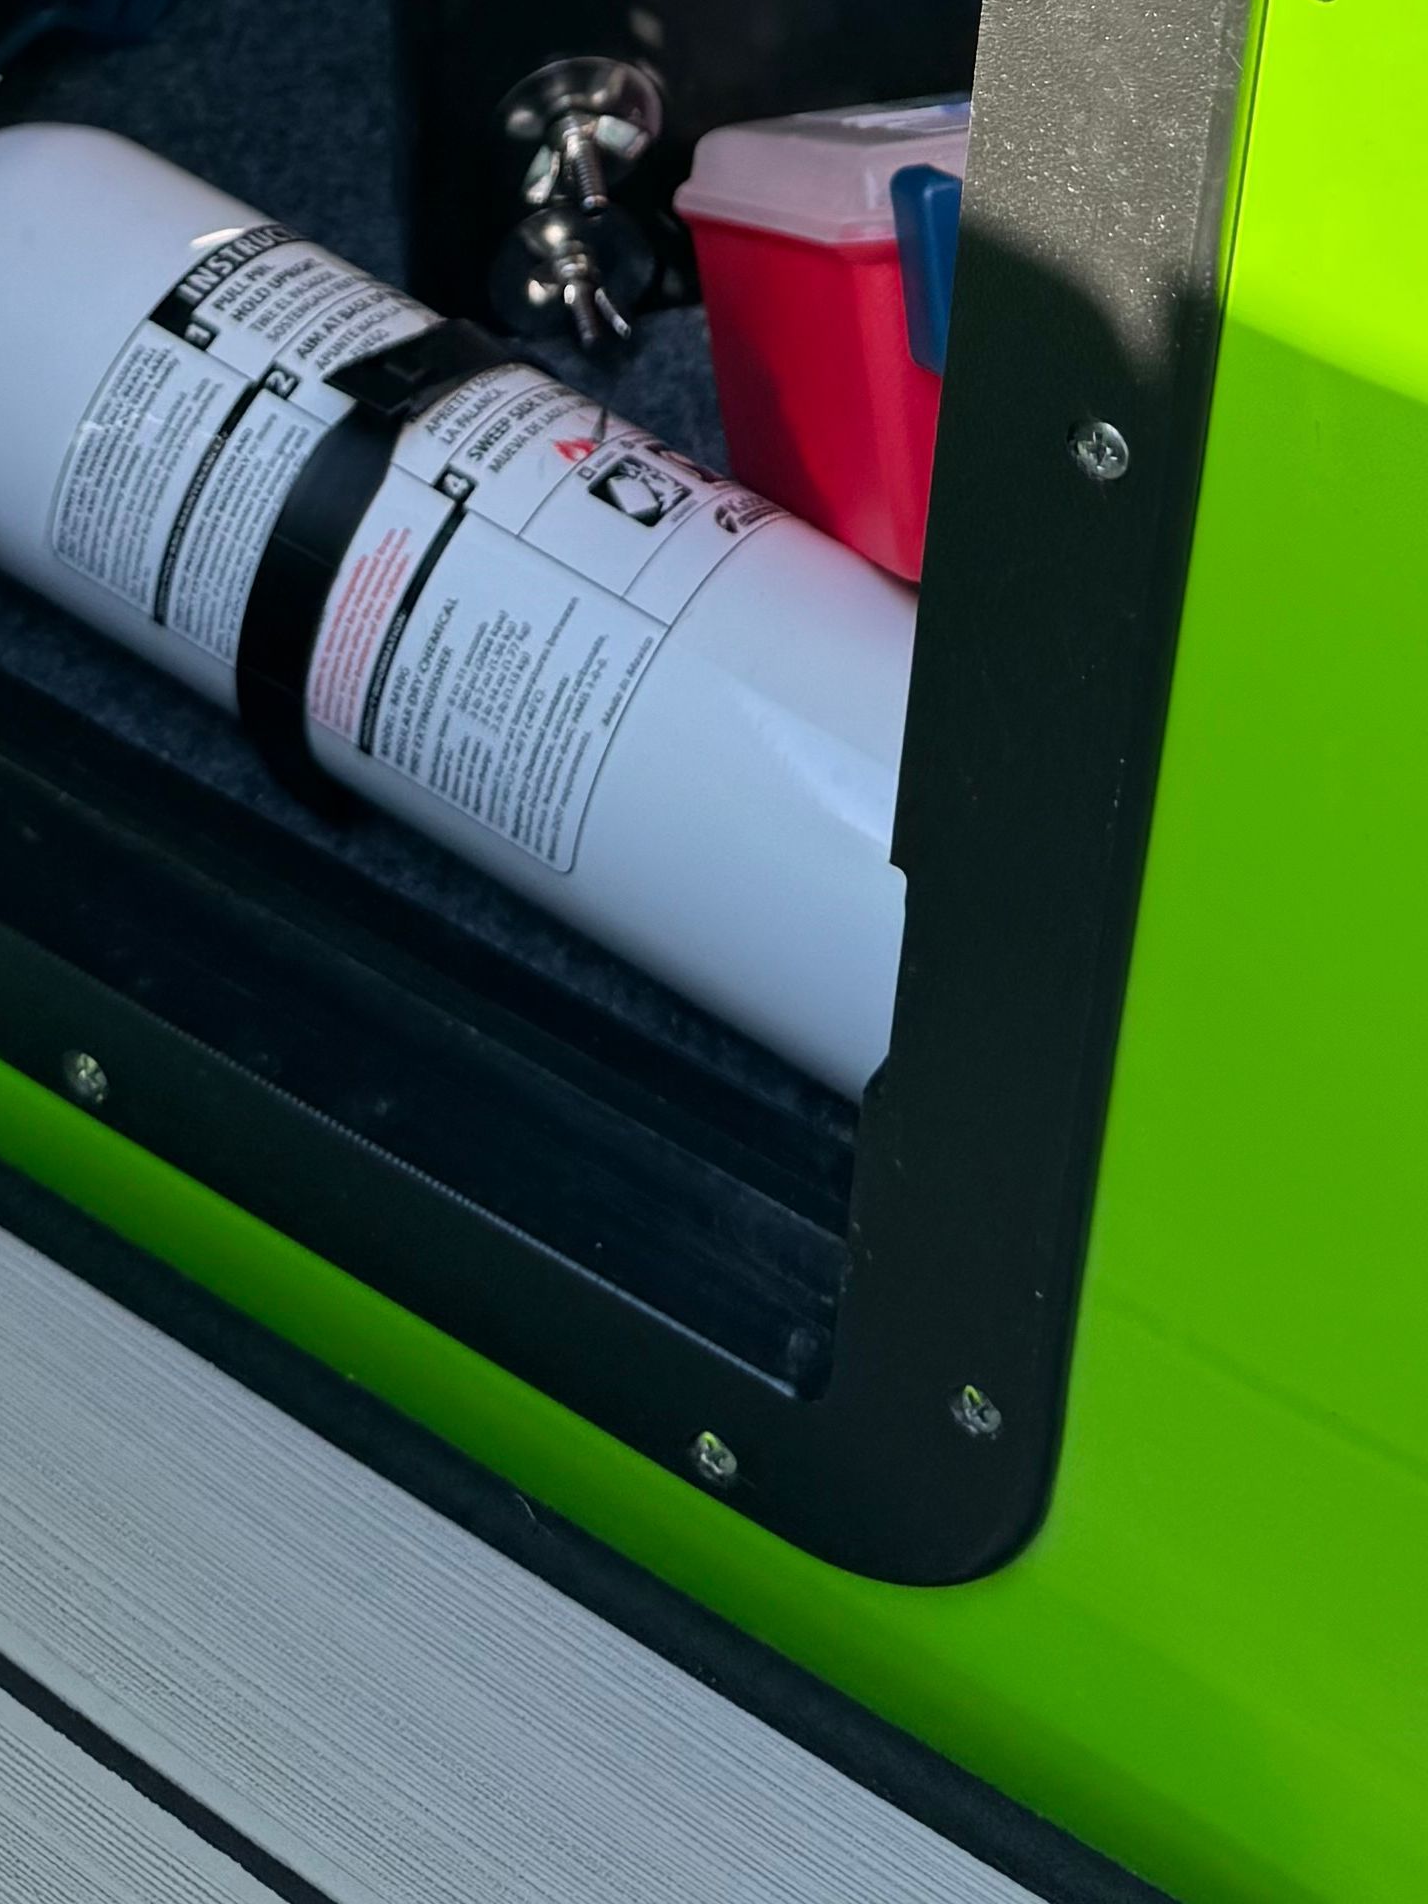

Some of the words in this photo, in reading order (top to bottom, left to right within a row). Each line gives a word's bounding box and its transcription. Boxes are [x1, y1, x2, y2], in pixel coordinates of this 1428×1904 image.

[174, 224, 295, 307] INSTRUC
[212, 277, 249, 313] PULL
[230, 283, 272, 322] HOLD
[248, 307, 277, 334] TIRE
[274, 294, 292, 312] EL
[264, 363, 297, 397] 2
[294, 328, 326, 359] AIM
[321, 314, 342, 334] AT
[313, 326, 360, 370] APUNTE
[424, 389, 470, 435] APRIETE
[440, 425, 461, 445] LA
[441, 467, 471, 498] 4
[465, 415, 513, 463] SWEEP
[487, 431, 529, 473] MUEVA
[525, 421, 541, 436] DE
[406, 672, 424, 706] DRY
[417, 595, 458, 673] CHEMICAL
[413, 645, 453, 749] EXTINGUISHER
